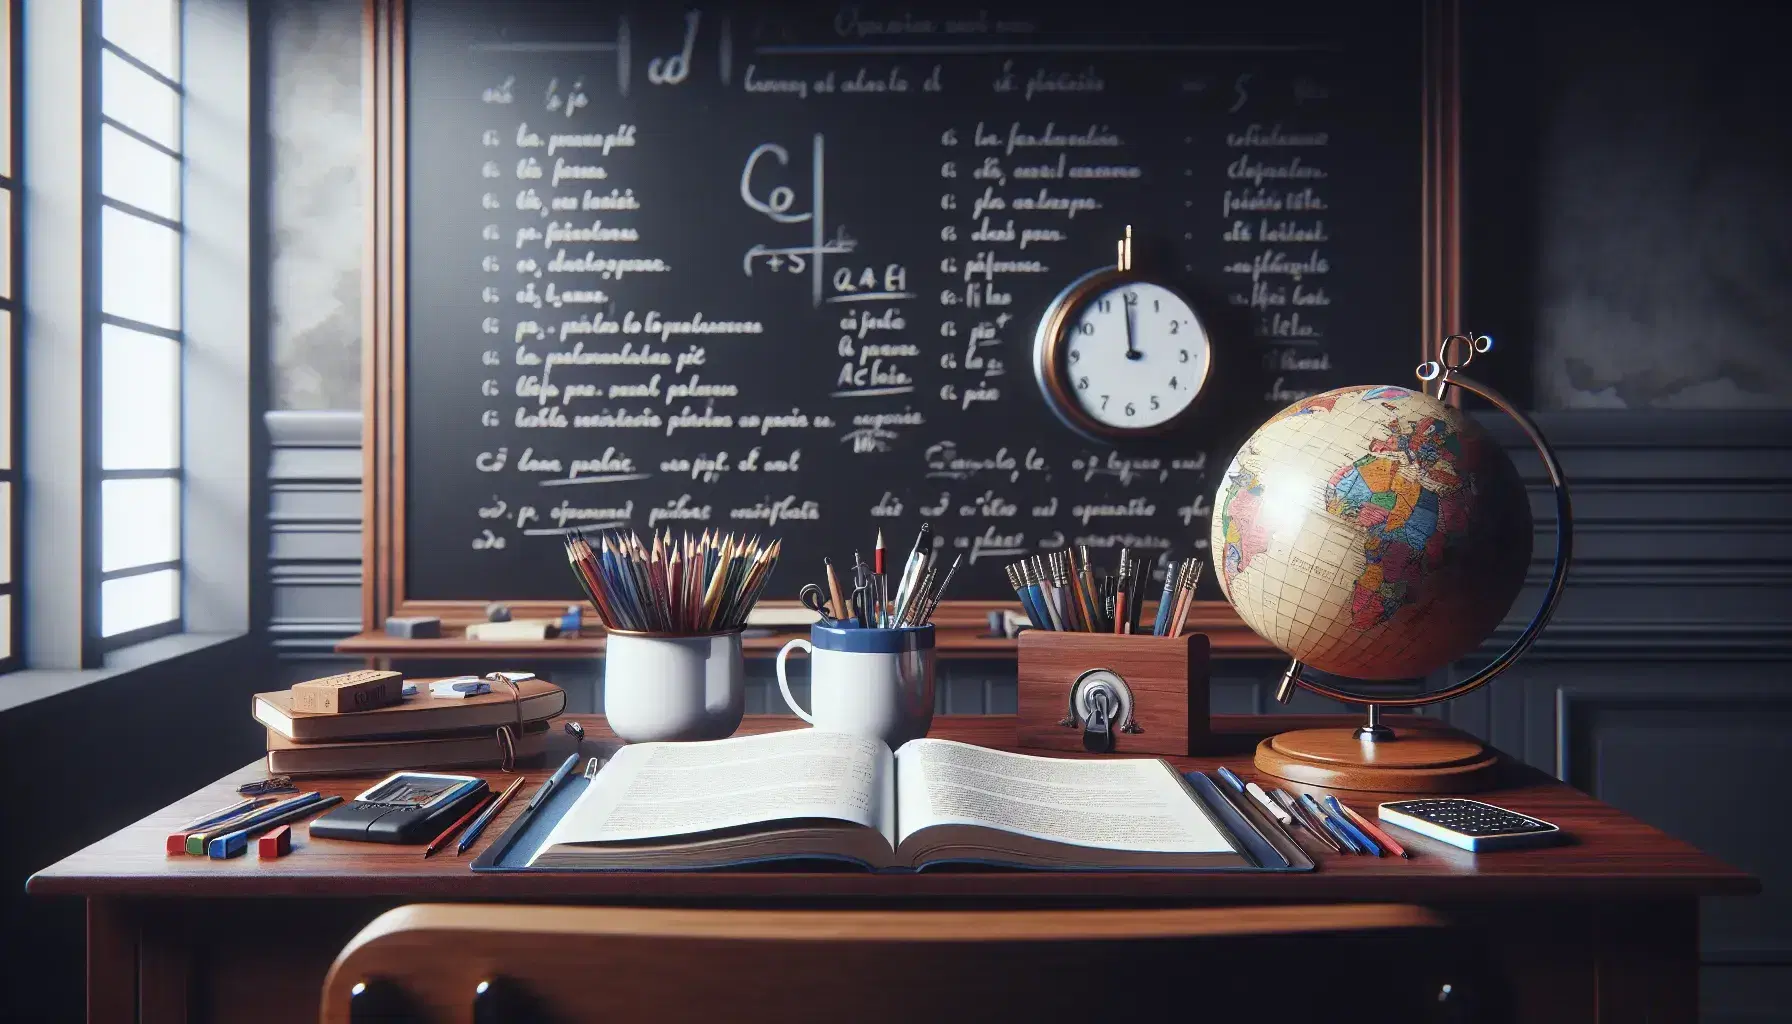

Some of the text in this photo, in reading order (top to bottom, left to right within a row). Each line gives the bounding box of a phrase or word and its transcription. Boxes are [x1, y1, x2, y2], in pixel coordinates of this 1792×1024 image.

[1123, 291, 1138, 306] 2
[1154, 299, 1161, 313] 1
[1170, 320, 1179, 335] 2
[1068, 351, 1080, 364] 9
[1178, 349, 1189, 363] 3
[1078, 376, 1089, 390] 8
[1168, 375, 1178, 390] 4
[1101, 395, 1110, 411] 7
[1125, 402, 1136, 417] 6
[1150, 395, 1160, 410] 5
